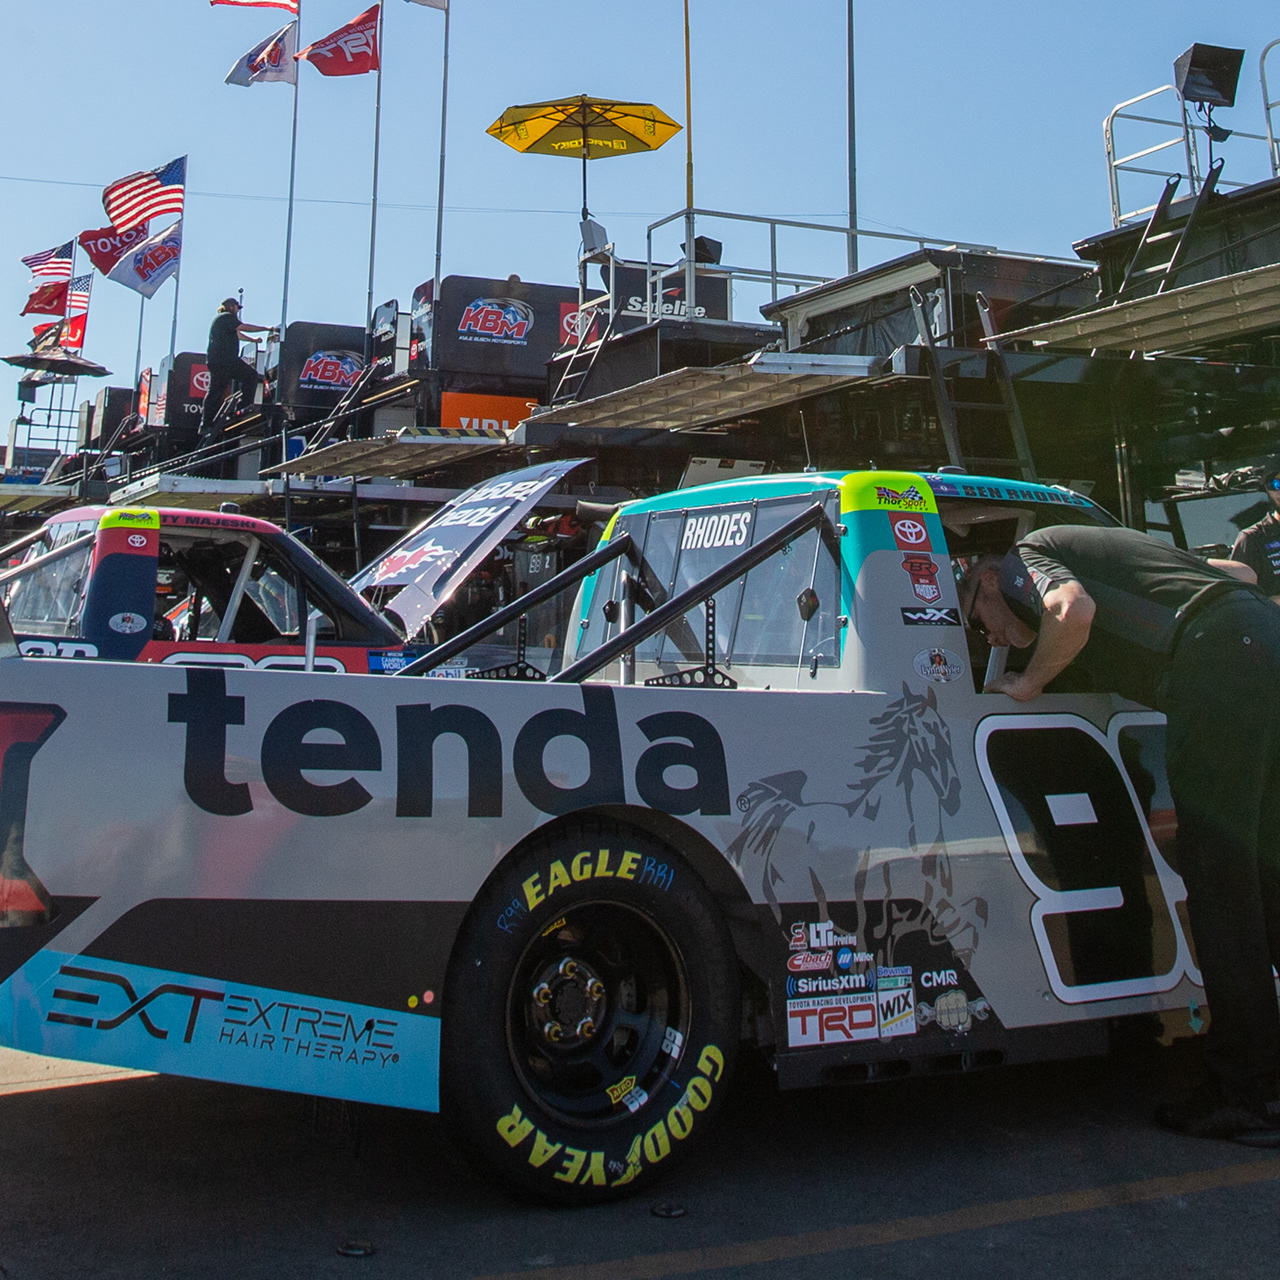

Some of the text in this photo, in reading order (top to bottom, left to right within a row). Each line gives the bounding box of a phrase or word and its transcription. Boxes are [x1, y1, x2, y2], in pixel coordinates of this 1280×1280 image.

[458, 305, 529, 340] KBM
[299, 357, 364, 387] KBM
[962, 484, 1086, 507] BEN RHODES
[184, 514, 256, 529] MAJESKI
[681, 511, 752, 550] RHODES
[167, 667, 732, 819] tenda
[522, 849, 642, 911] EAGLE
[787, 951, 833, 970] Eibach
[853, 952, 874, 962] Miller
[877, 966, 912, 976] Bowman
[812, 998, 834, 1006] RACING
[835, 995, 875, 1005] DEVELOPMENT
[880, 990, 913, 1021] WIX
[224, 994, 398, 1050] EXTREME
[789, 1003, 877, 1042] TRD
[219, 1026, 276, 1052] HAIR
